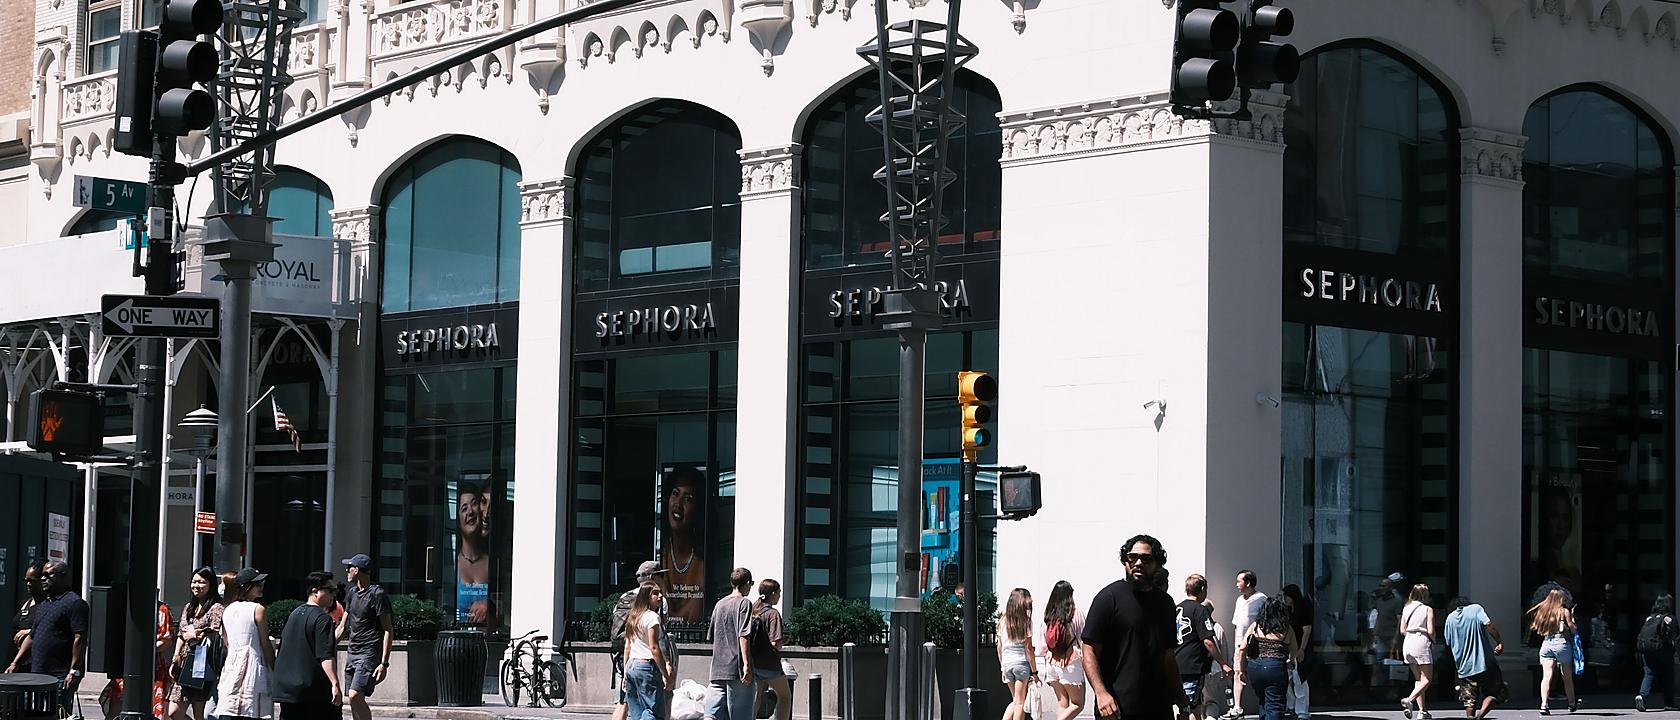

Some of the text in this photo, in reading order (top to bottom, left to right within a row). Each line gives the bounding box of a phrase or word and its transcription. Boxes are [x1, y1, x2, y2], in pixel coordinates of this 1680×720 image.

[106, 184, 134, 206] 5 Av
[829, 279, 970, 318] SEPRA
[1300, 267, 1442, 312] SEPHORA
[118, 308, 209, 325] ONE WAY
[594, 302, 714, 338] SEPHORA
[1534, 296, 1659, 336] SEPHORA
[396, 322, 498, 355] SEPHORA
